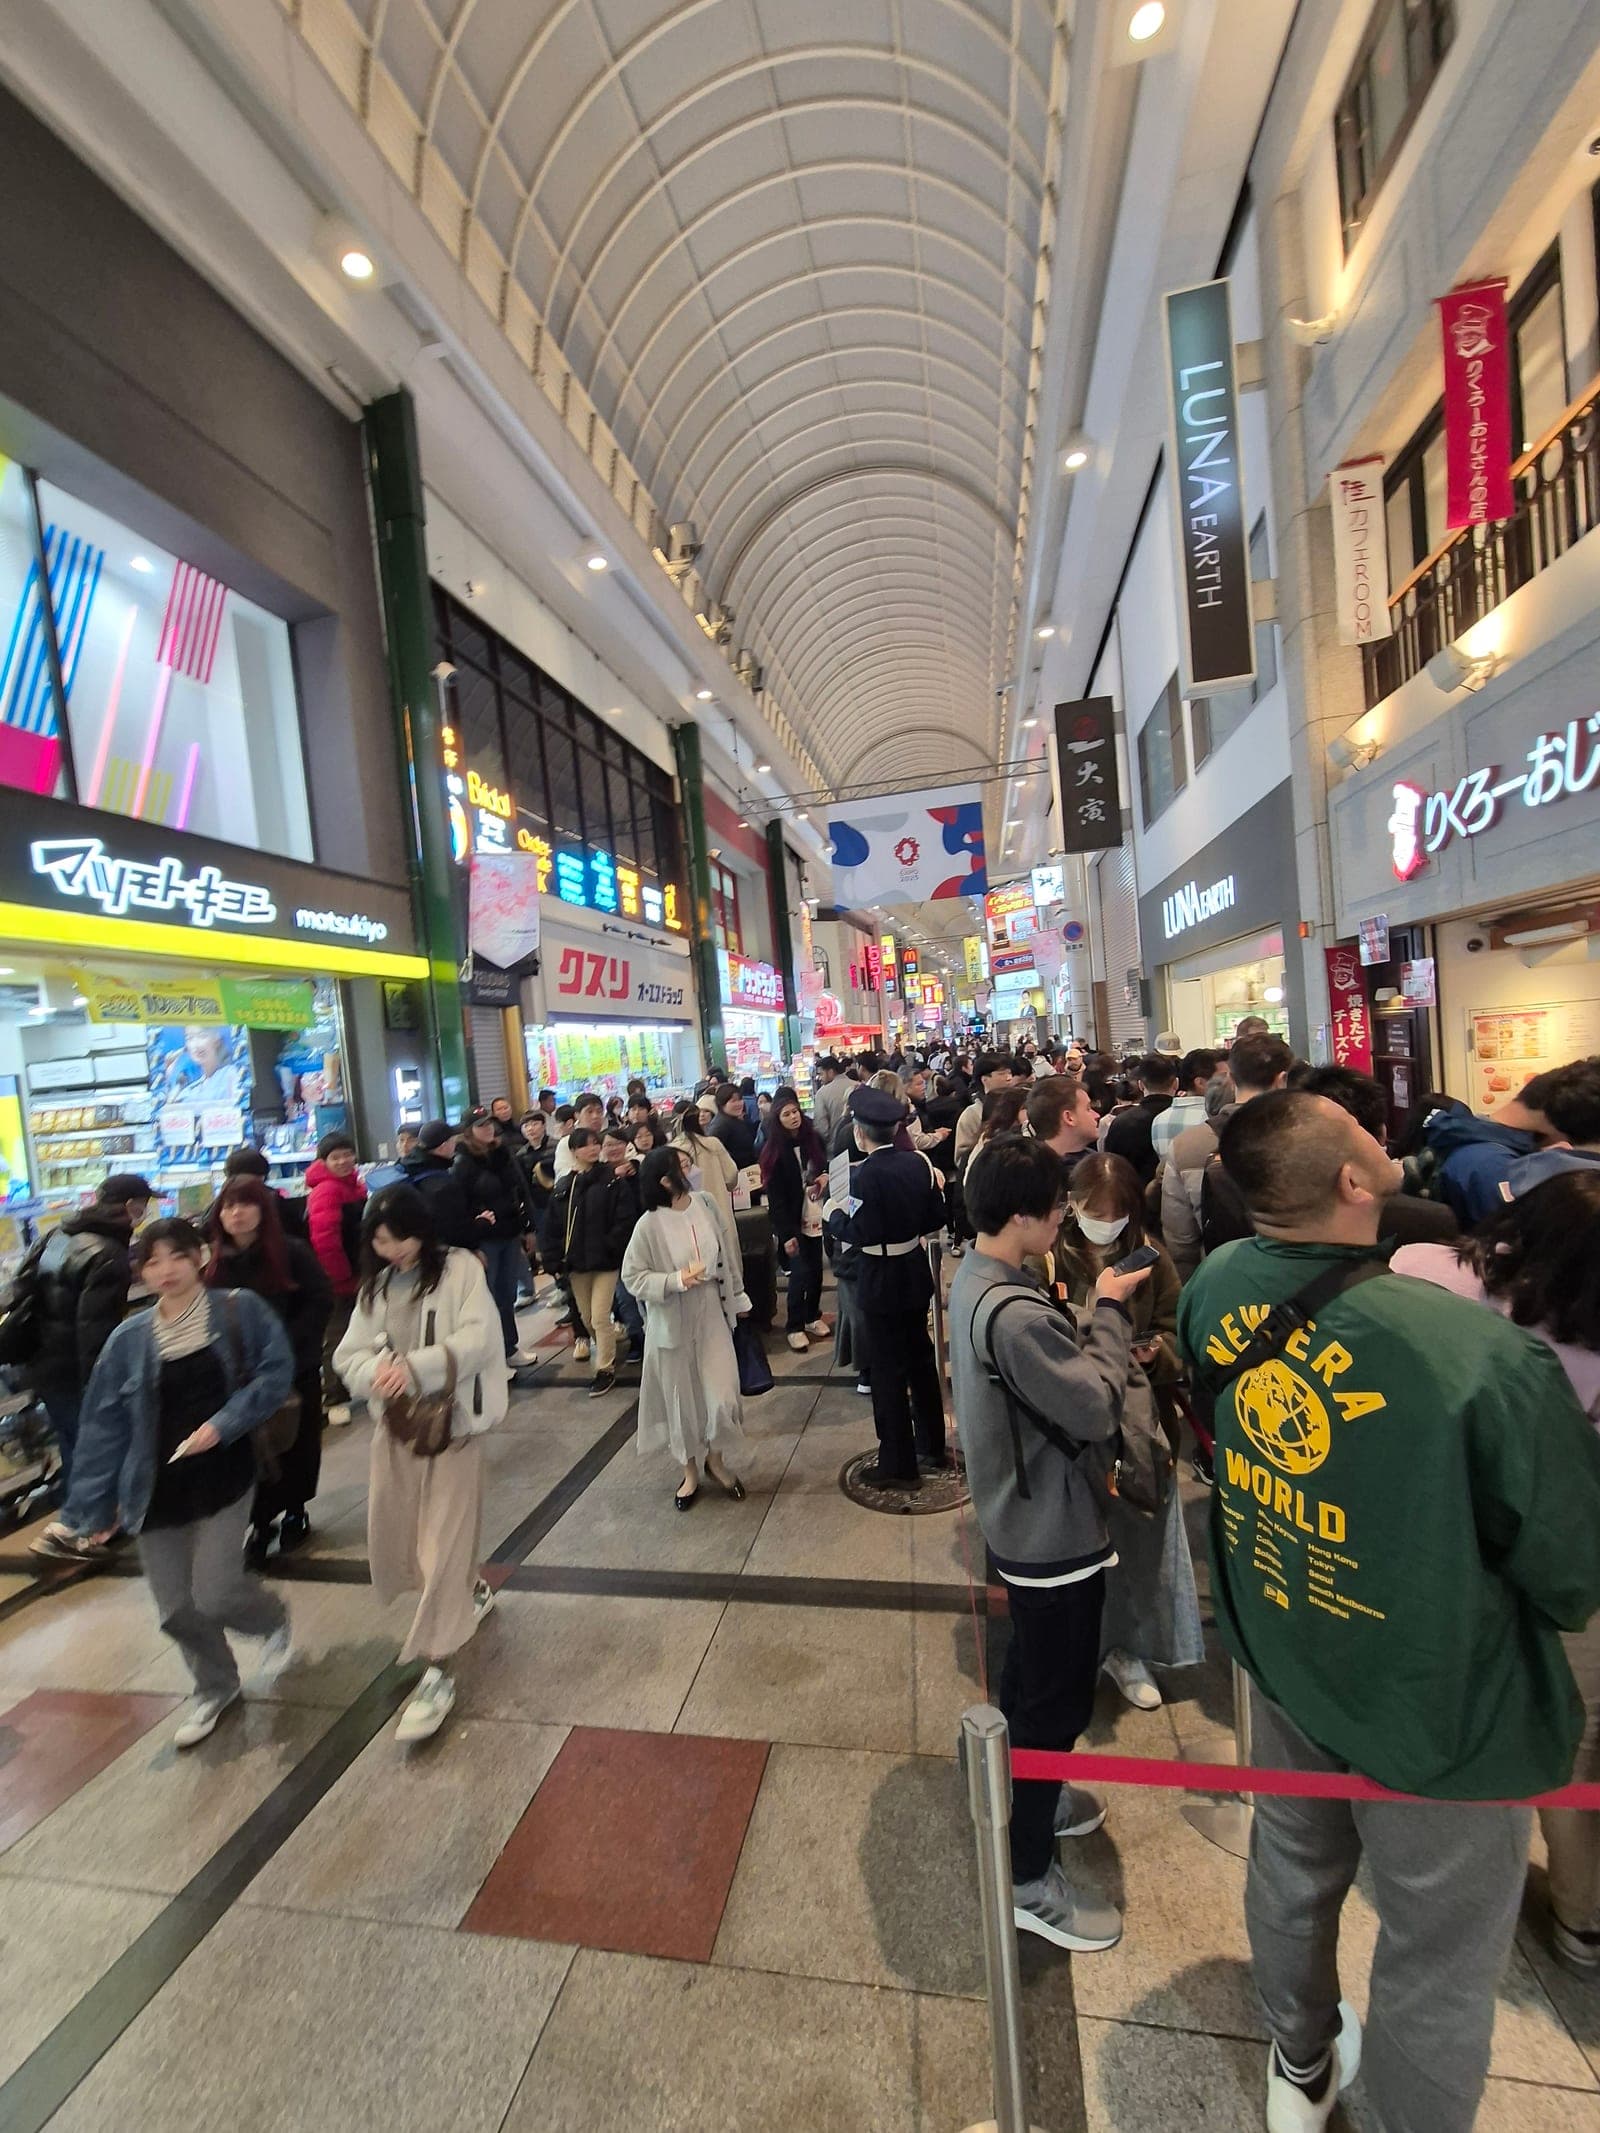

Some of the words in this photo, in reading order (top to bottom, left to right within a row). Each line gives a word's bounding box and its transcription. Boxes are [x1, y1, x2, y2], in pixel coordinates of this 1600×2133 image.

[1180, 360, 1232, 509] LUNA
[1190, 513, 1223, 608] EARTH
[1424, 711, 1600, 852] りくろーおじ
[295, 908, 388, 943] matsukiyo
[1162, 880, 1203, 939] LUNA
[558, 947, 630, 1000] クスリ
[868, 945, 880, 992] 551
[1333, 1009, 1350, 1068] チーズケ
[1347, 994, 1365, 1049] 焼きたて
[1206, 1304, 1271, 1366] NEW
[1285, 1319, 1388, 1422] ERA
[1225, 1447, 1347, 1544] WORLD
[1307, 1543, 1332, 1559] Hong
[1333, 1553, 1359, 1569] Kong
[1307, 1556, 1336, 1572] Tokyo
[1307, 1569, 1334, 1585] Seoul
[1308, 1595, 1350, 1620] Shanghai
